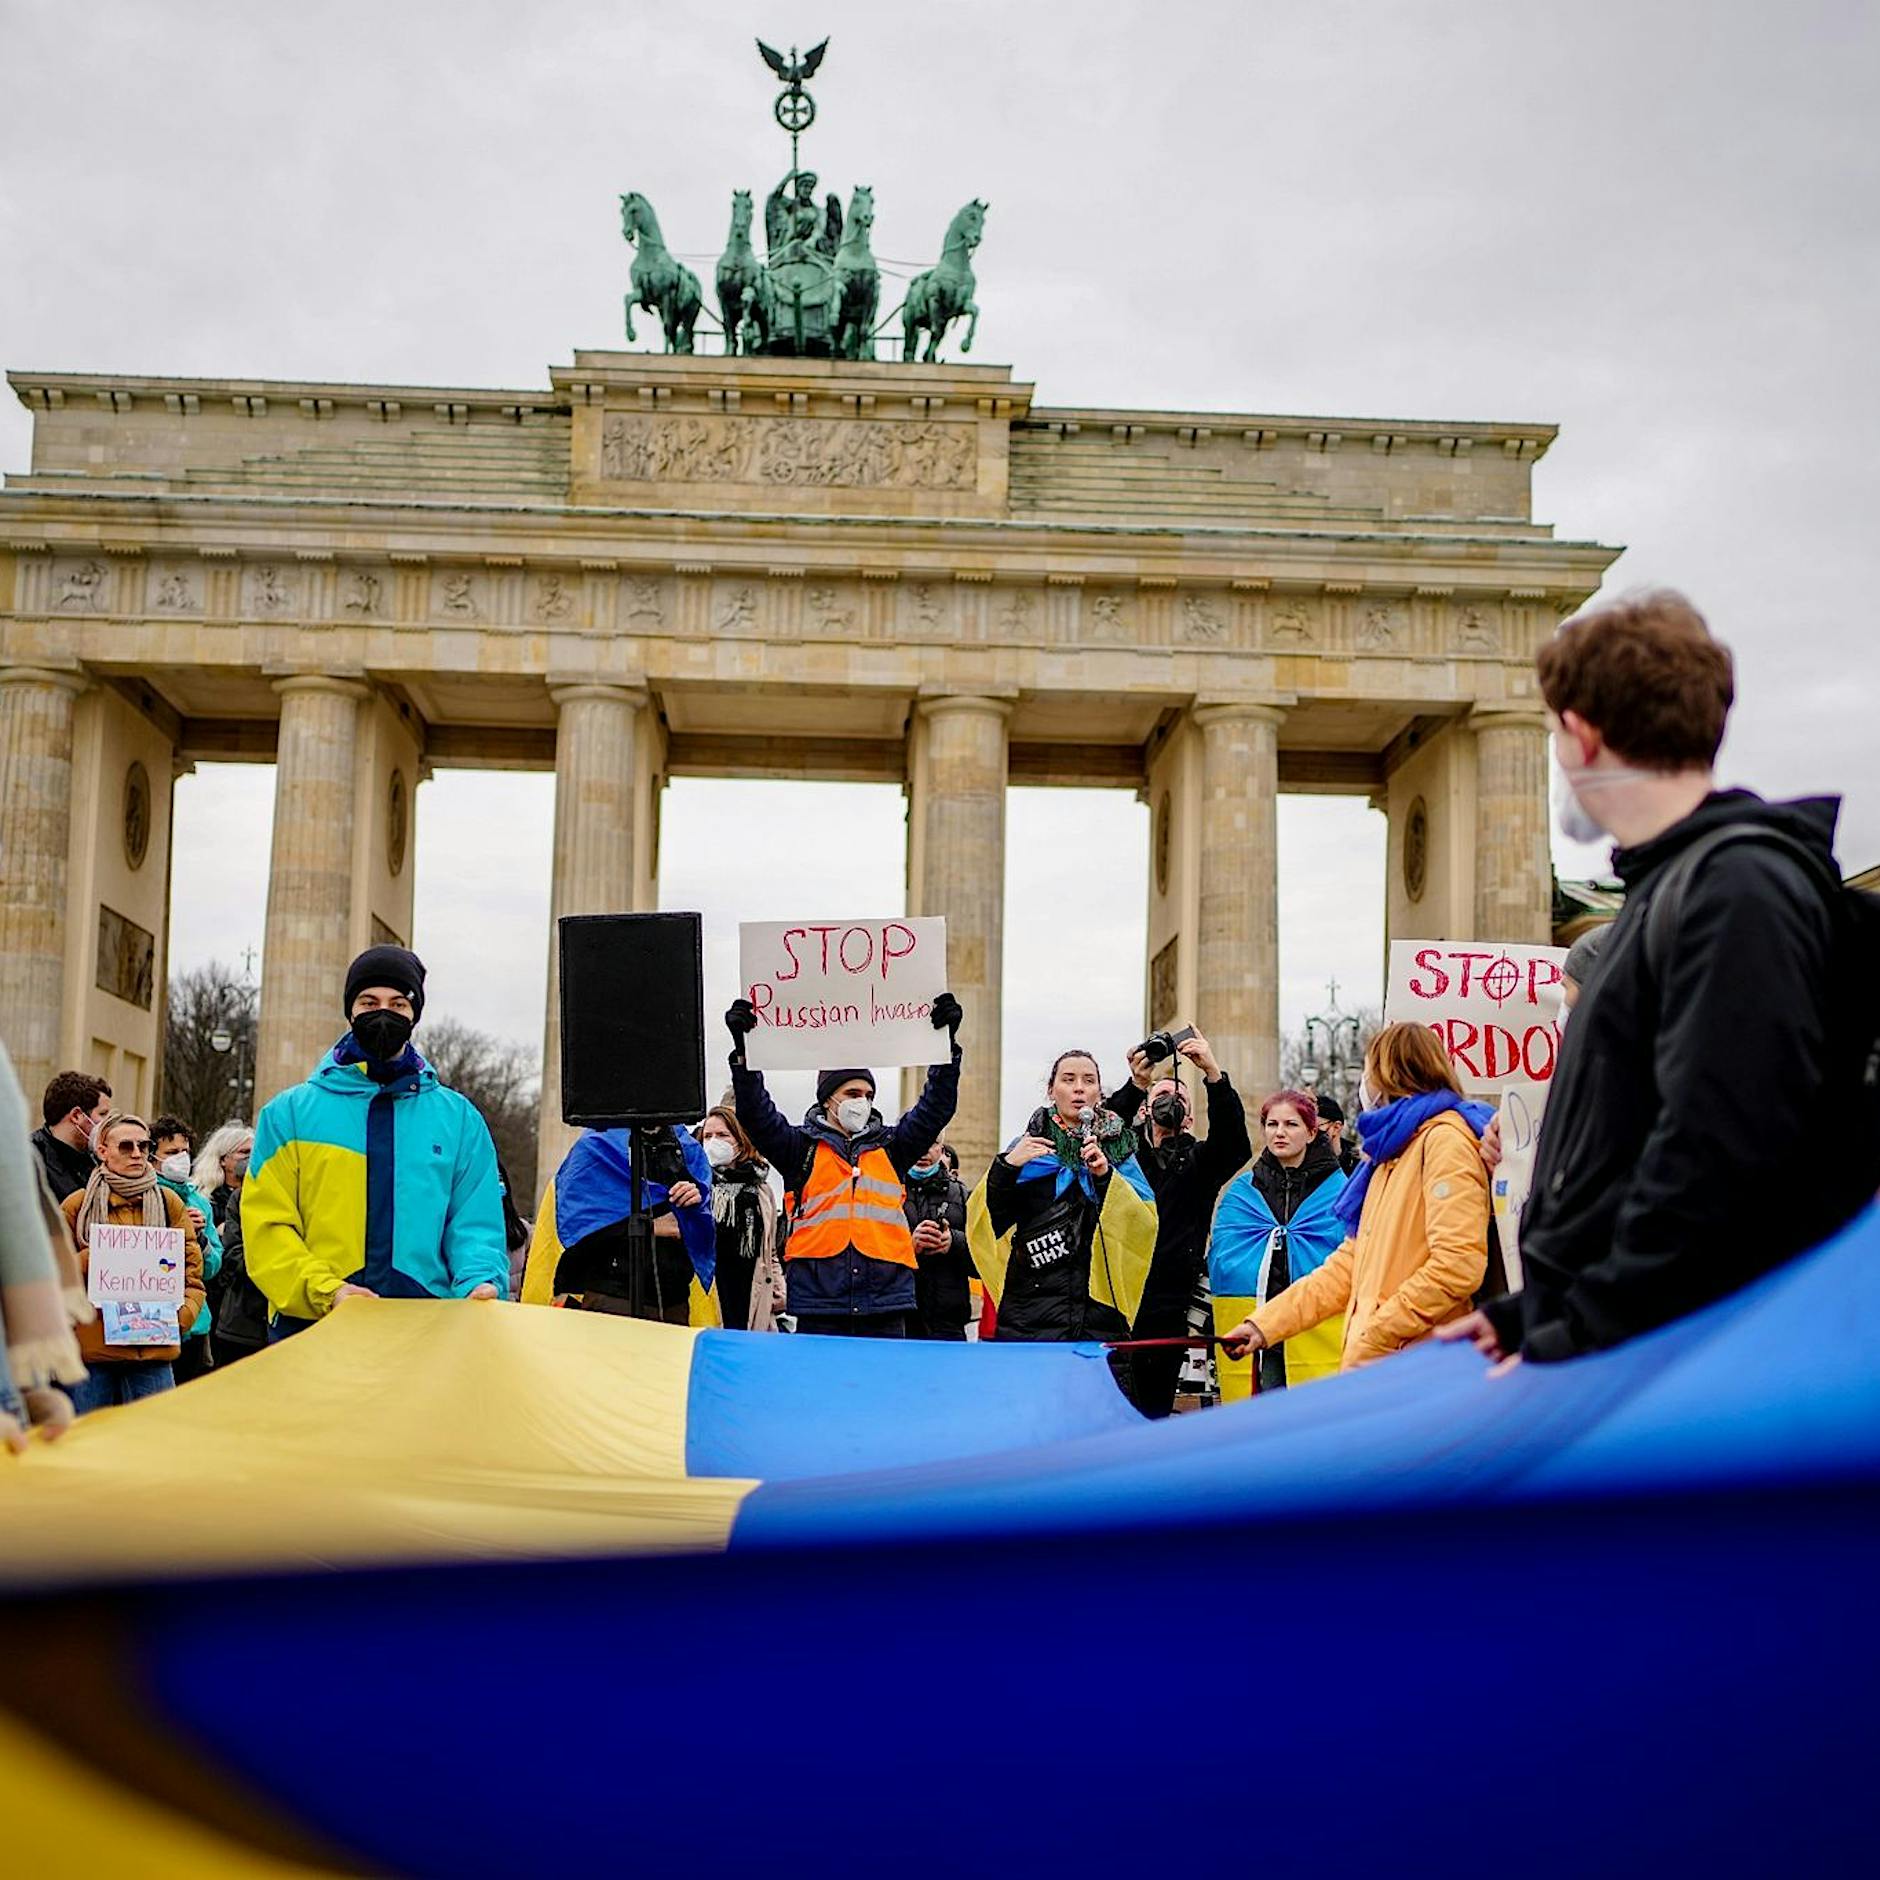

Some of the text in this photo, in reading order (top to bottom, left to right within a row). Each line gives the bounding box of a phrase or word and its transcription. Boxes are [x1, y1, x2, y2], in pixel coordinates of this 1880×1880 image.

[776, 923, 916, 980] STOP
[1409, 949, 1563, 1008] STOP
[750, 984, 858, 1028] Russian
[98, 1228, 178, 1251] МИРУ МИР
[1026, 1229, 1063, 1254] ПТН
[99, 1267, 177, 1294] Kein Krieg
